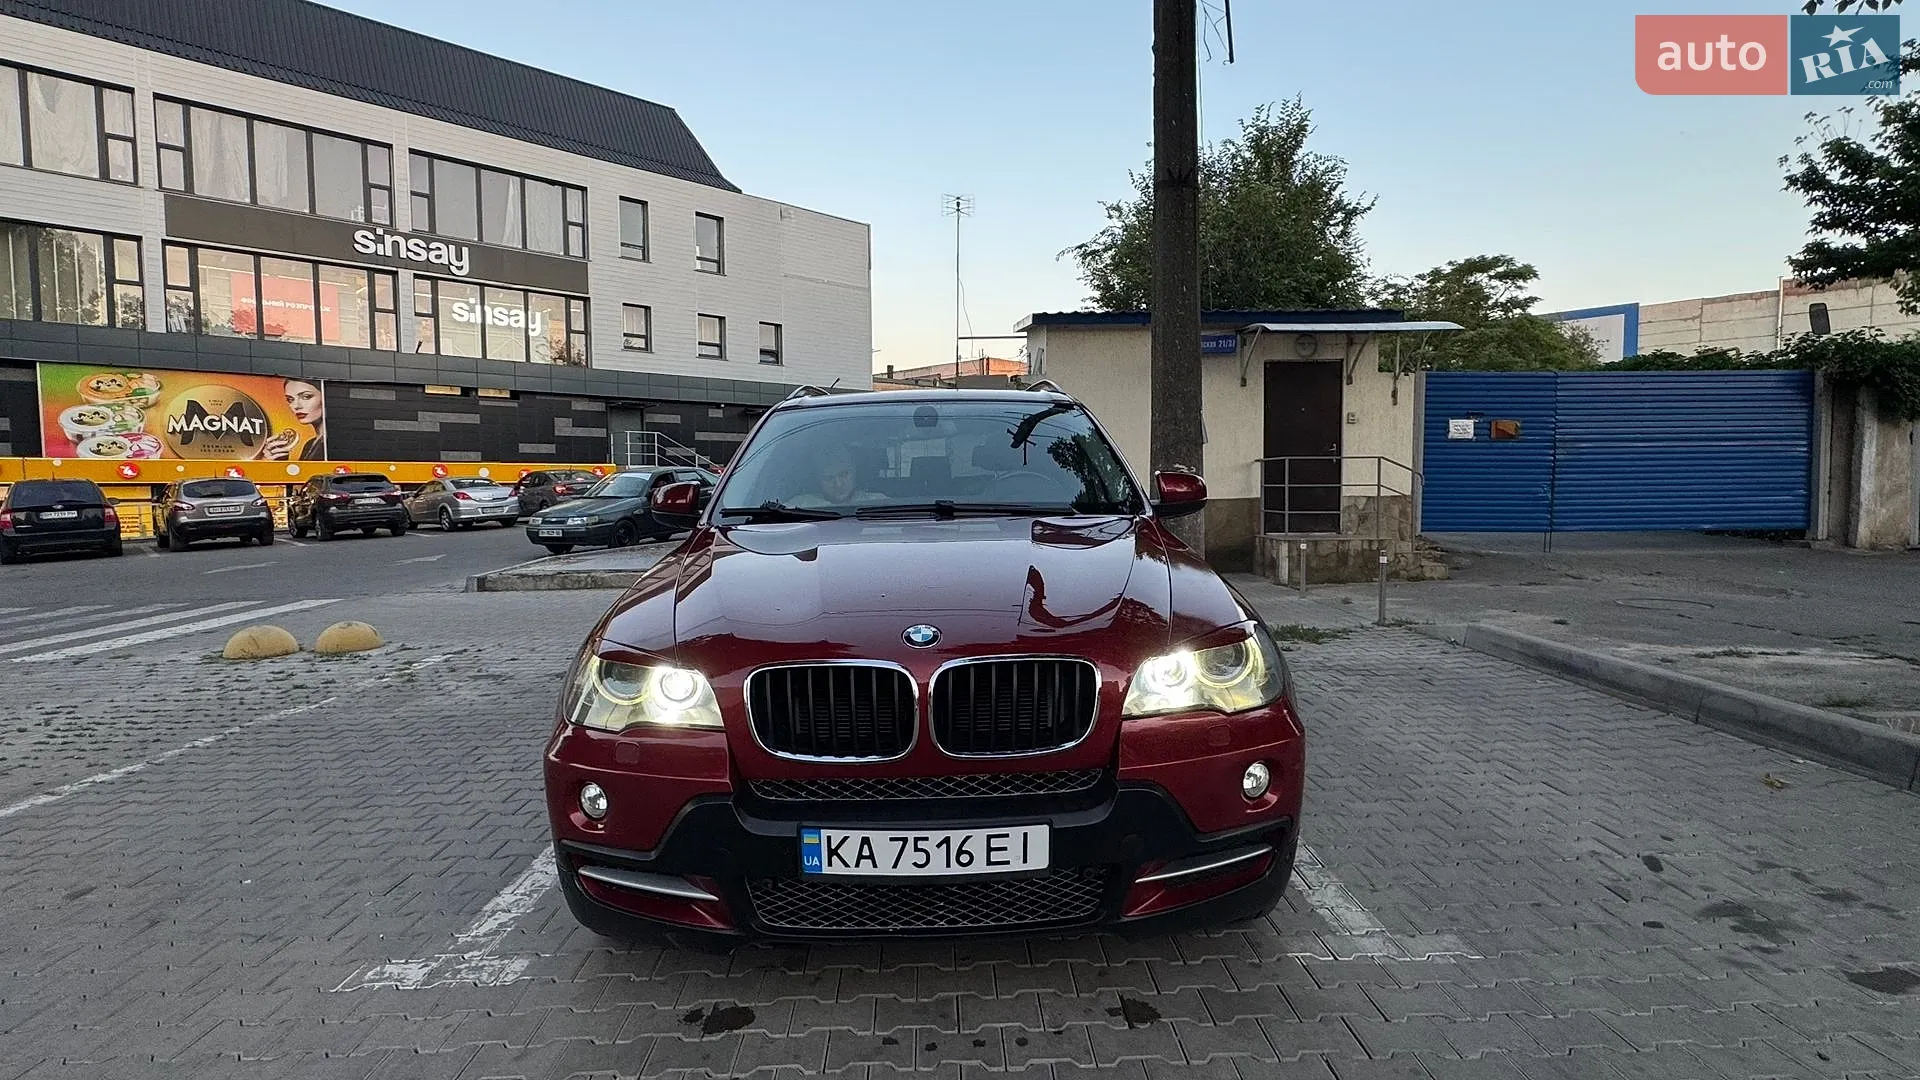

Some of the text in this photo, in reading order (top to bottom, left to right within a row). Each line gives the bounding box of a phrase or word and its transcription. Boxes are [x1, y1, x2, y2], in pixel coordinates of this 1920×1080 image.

[353, 228, 470, 276] sinsay
[451, 297, 541, 336] sinsay
[167, 413, 264, 435] MAGNAT
[804, 832, 1029, 869] UA KA 7516 EI
